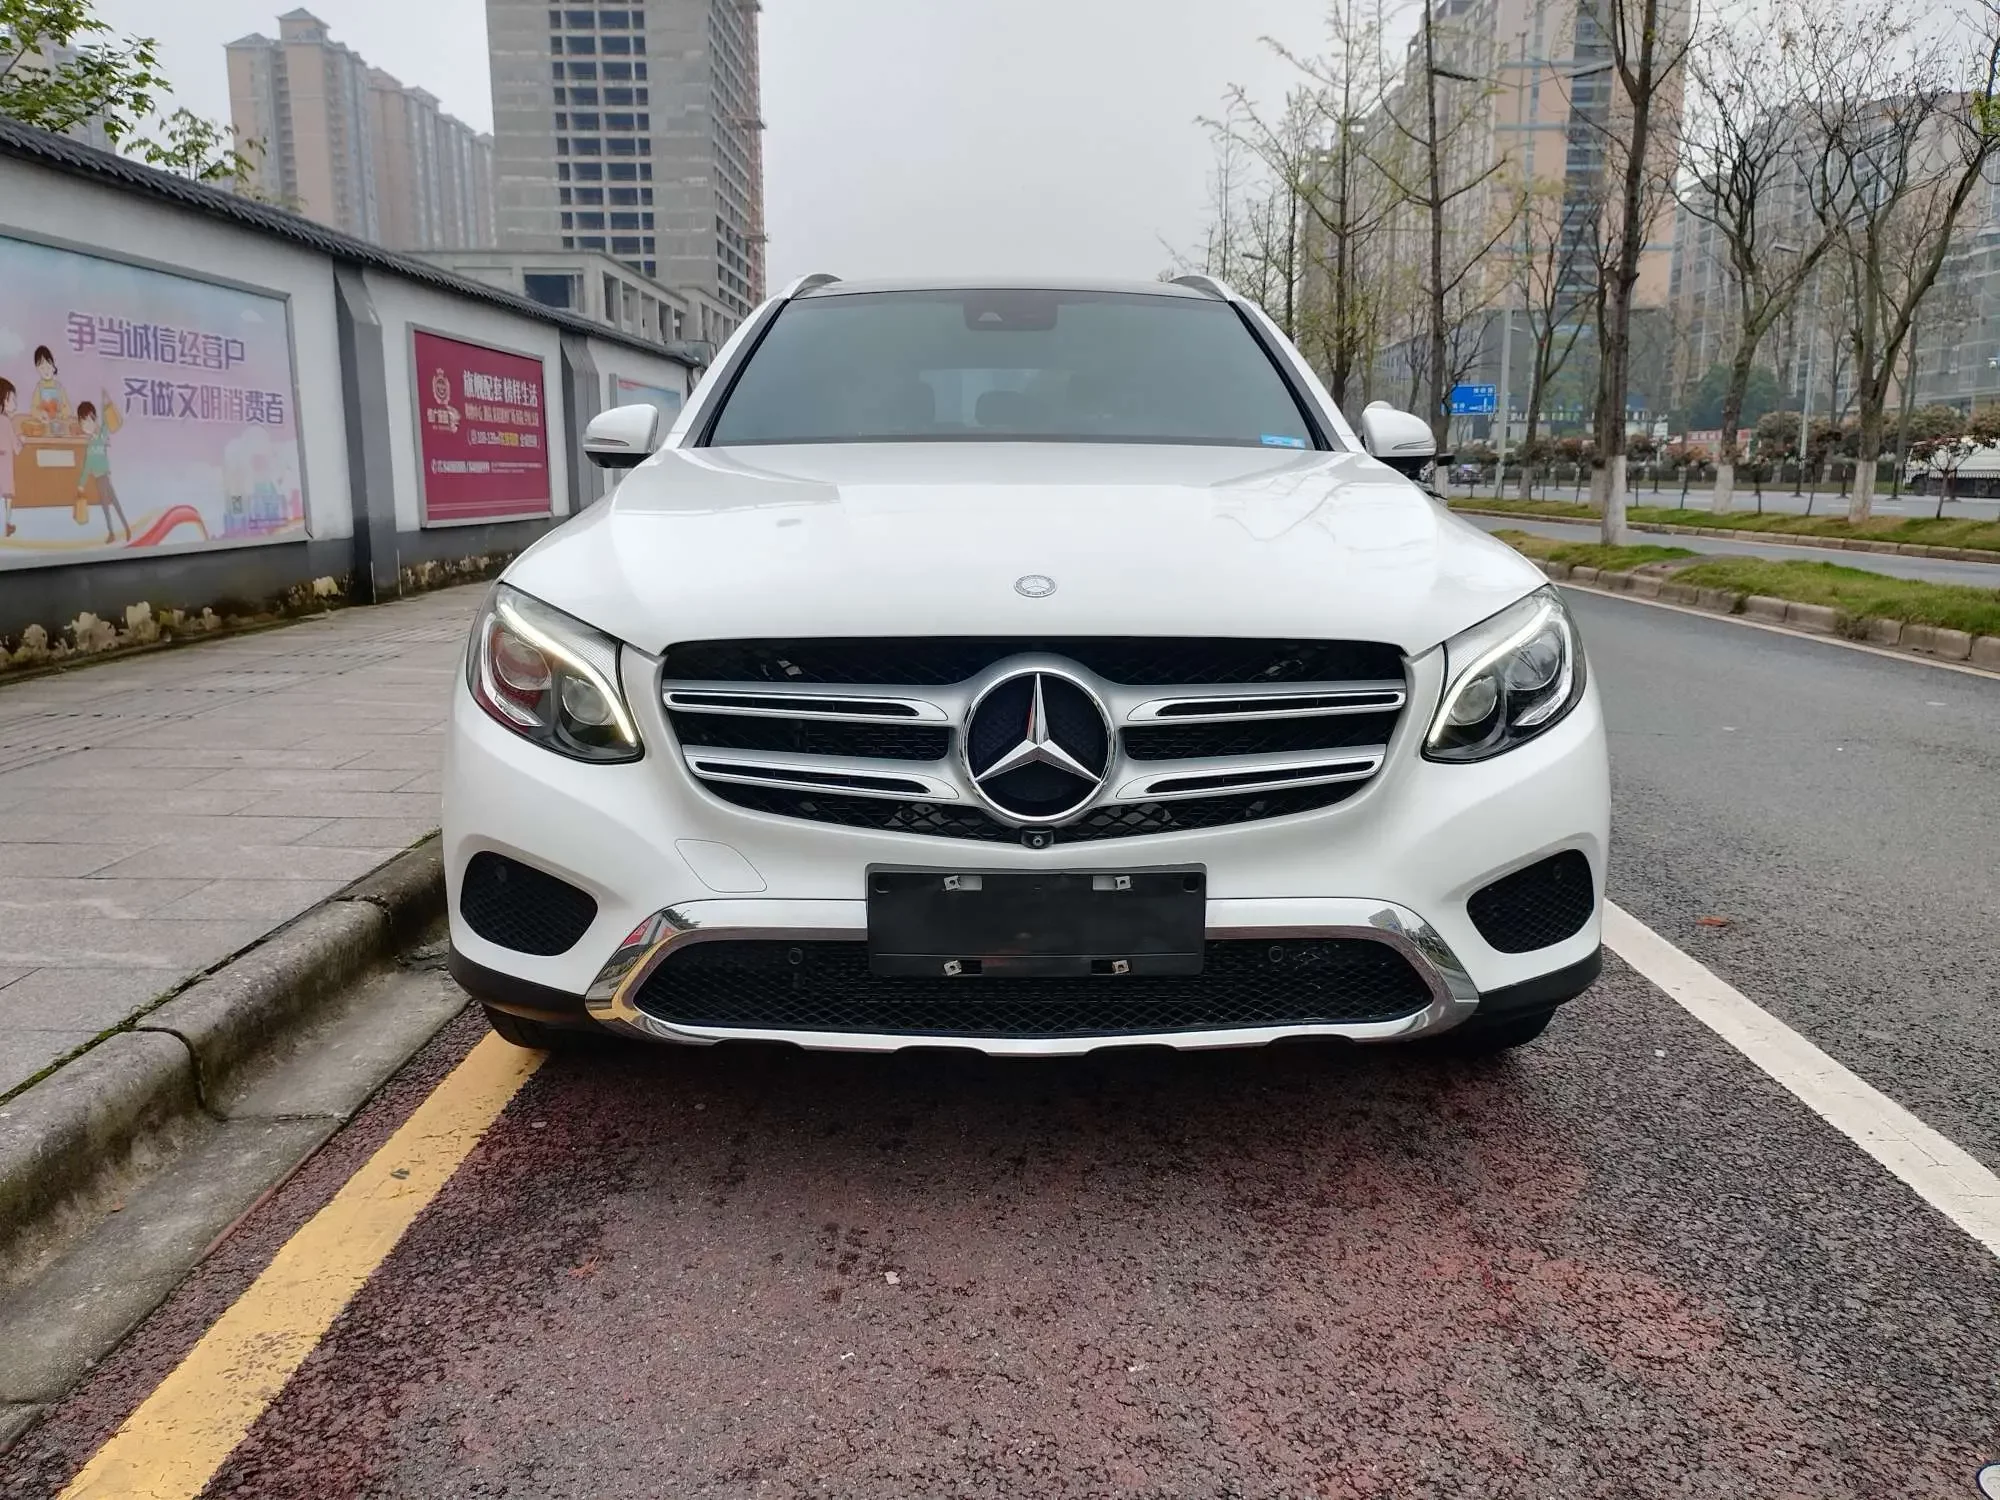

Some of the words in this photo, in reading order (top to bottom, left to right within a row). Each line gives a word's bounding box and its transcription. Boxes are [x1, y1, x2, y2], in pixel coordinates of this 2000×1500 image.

[67, 311, 245, 370] 争当诚信经营户
[124, 377, 284, 425] 齐做文明消费者
